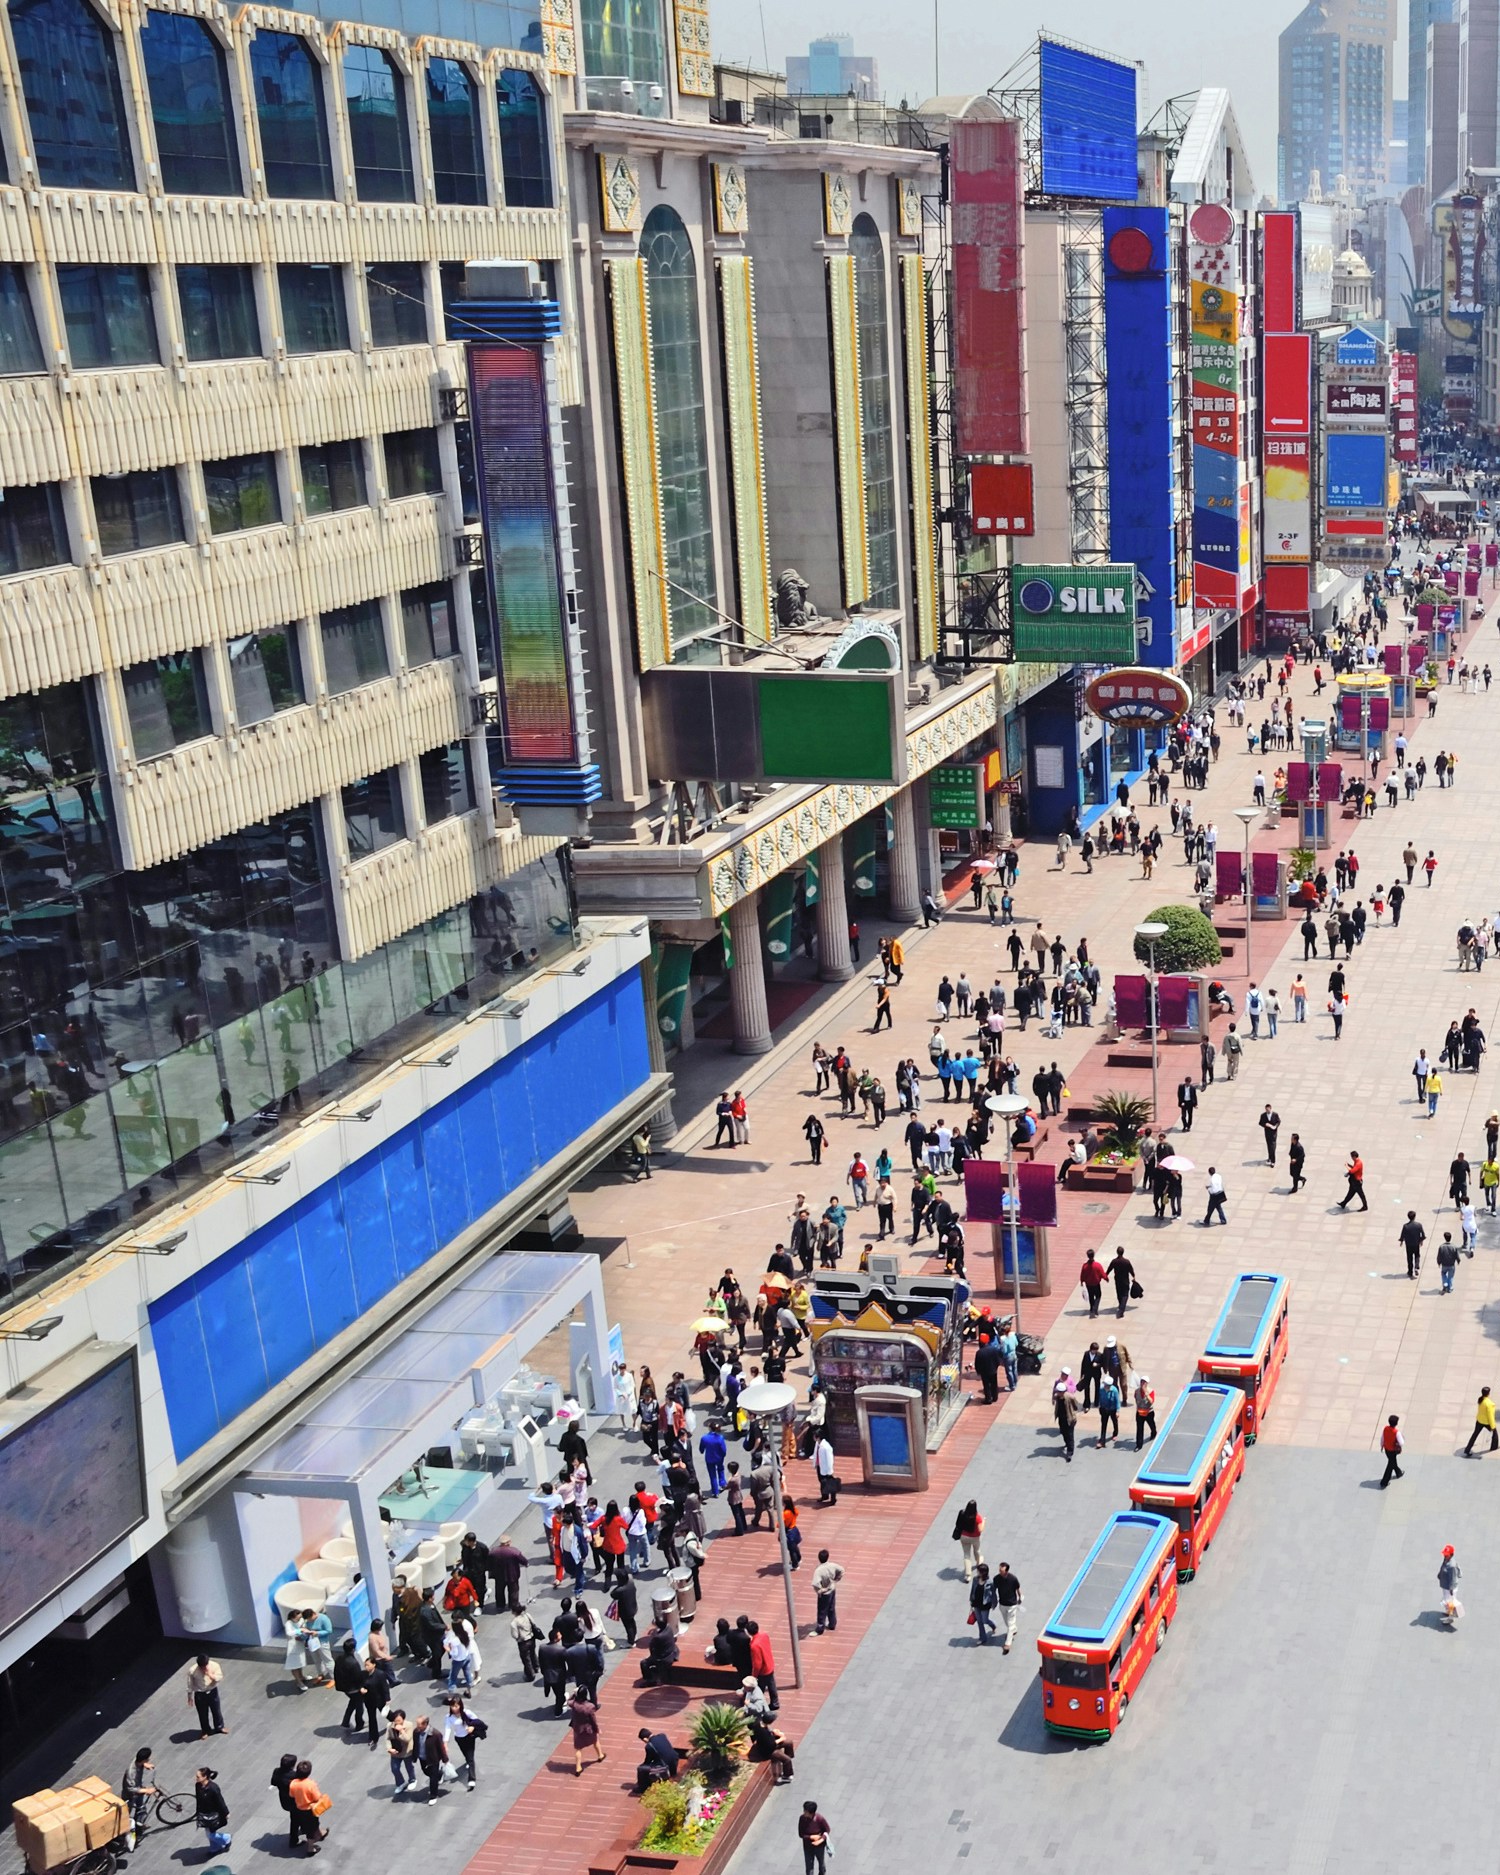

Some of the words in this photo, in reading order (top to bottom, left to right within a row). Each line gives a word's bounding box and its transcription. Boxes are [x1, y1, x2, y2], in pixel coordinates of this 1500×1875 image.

[1193, 345, 1235, 356] 旅游纪念品
[1193, 356, 1235, 369] 展示中心
[1218, 373, 1232, 385] 6F
[1206, 432, 1234, 443] 4-5F
[1267, 442, 1306, 455] 珍珠城
[1331, 485, 1361, 495] 珍珠城
[1060, 587, 1126, 614] SILK
